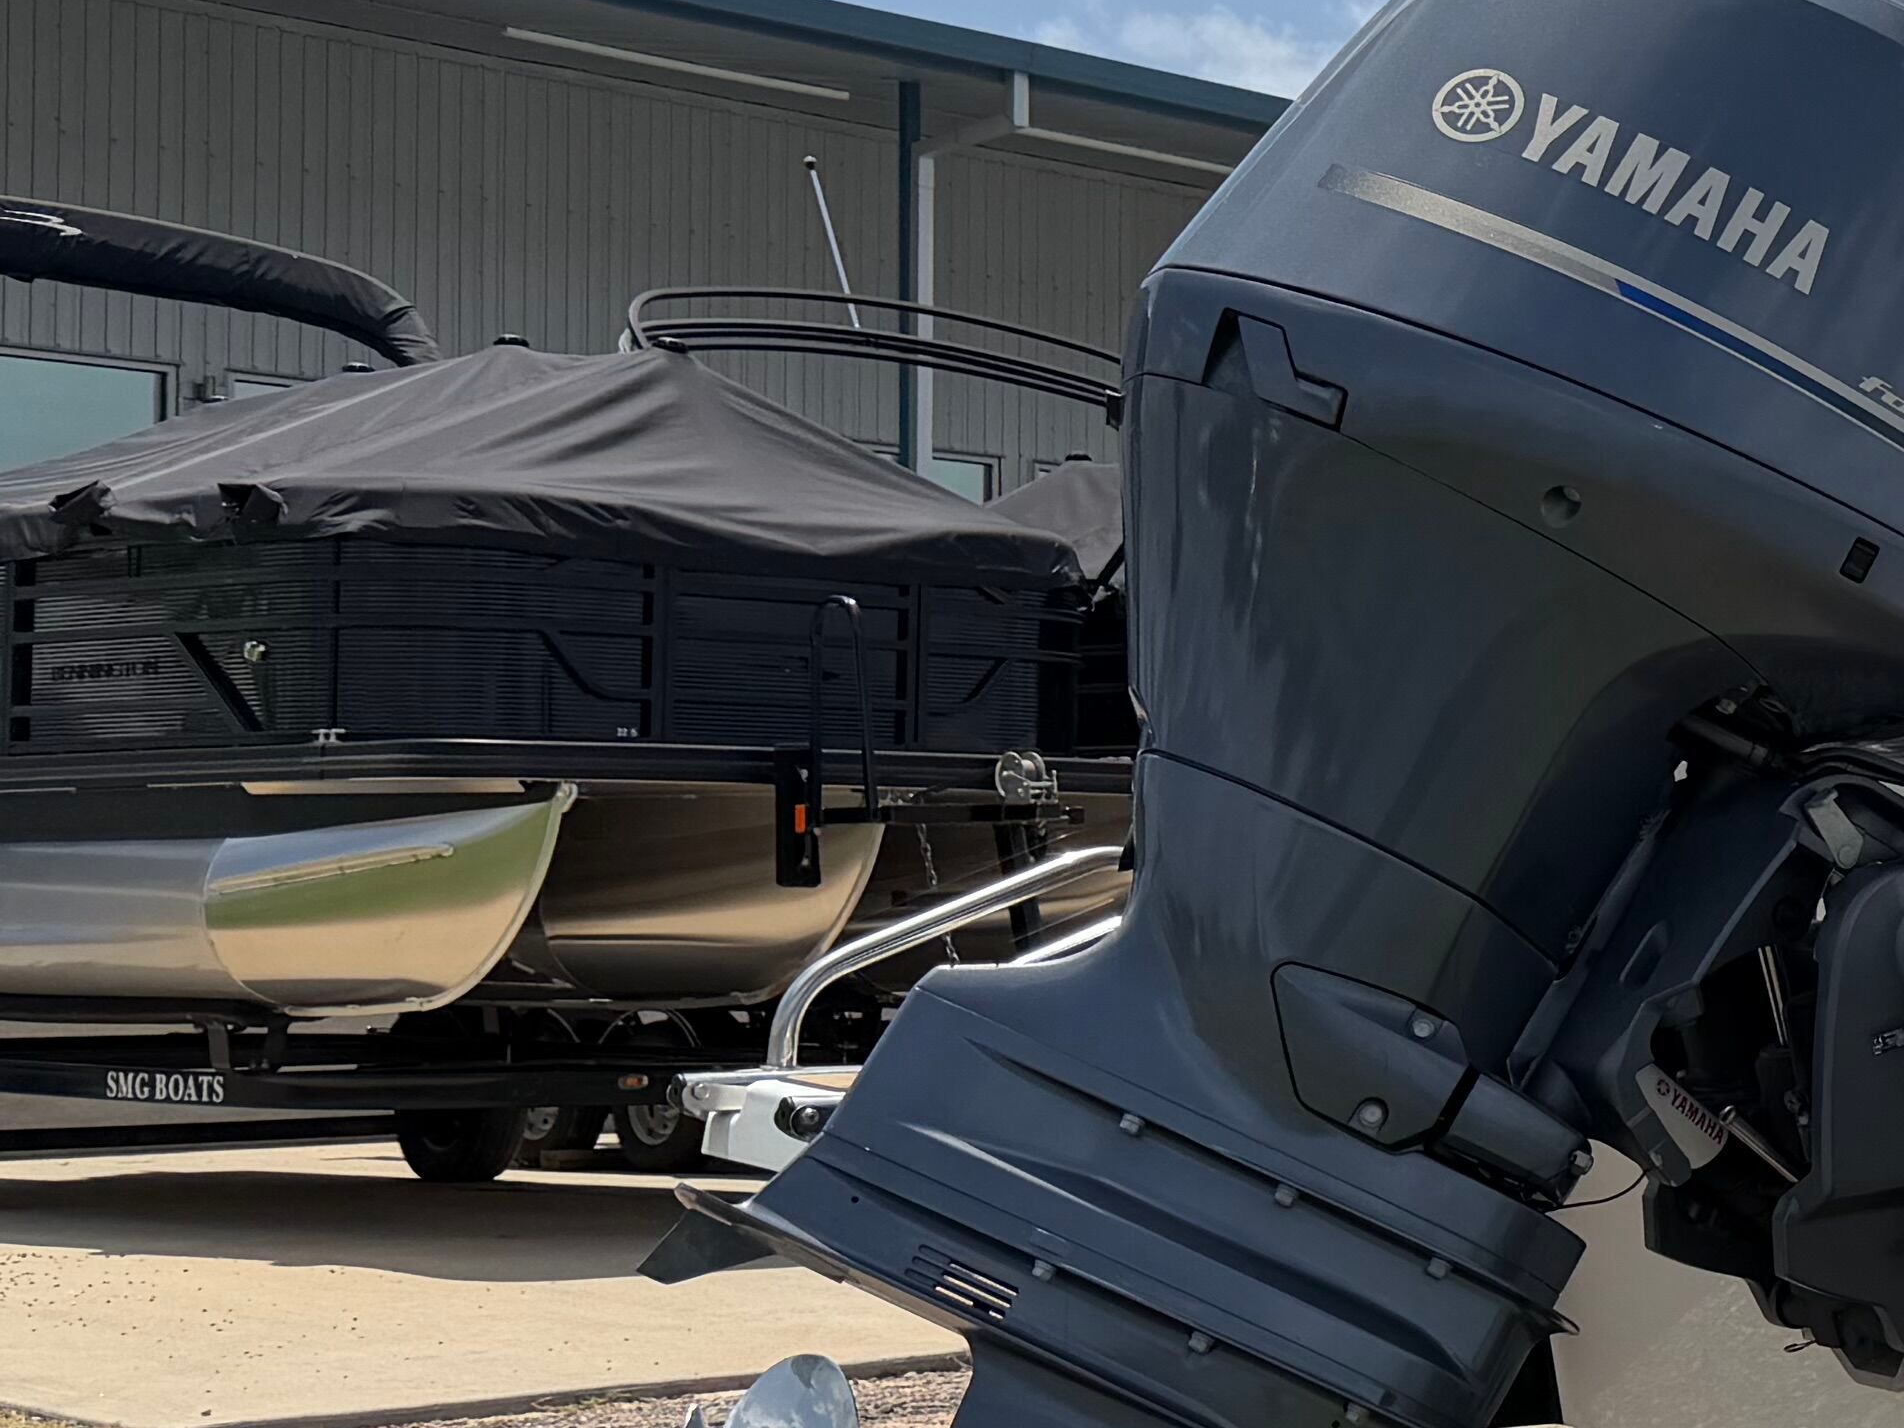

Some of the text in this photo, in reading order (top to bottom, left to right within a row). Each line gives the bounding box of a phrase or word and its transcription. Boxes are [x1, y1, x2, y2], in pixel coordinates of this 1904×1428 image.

[1521, 92, 1830, 295] YAMAHA
[106, 1071, 224, 1103] SMG BOATS
[1671, 1088, 1724, 1145] YAMAHA
